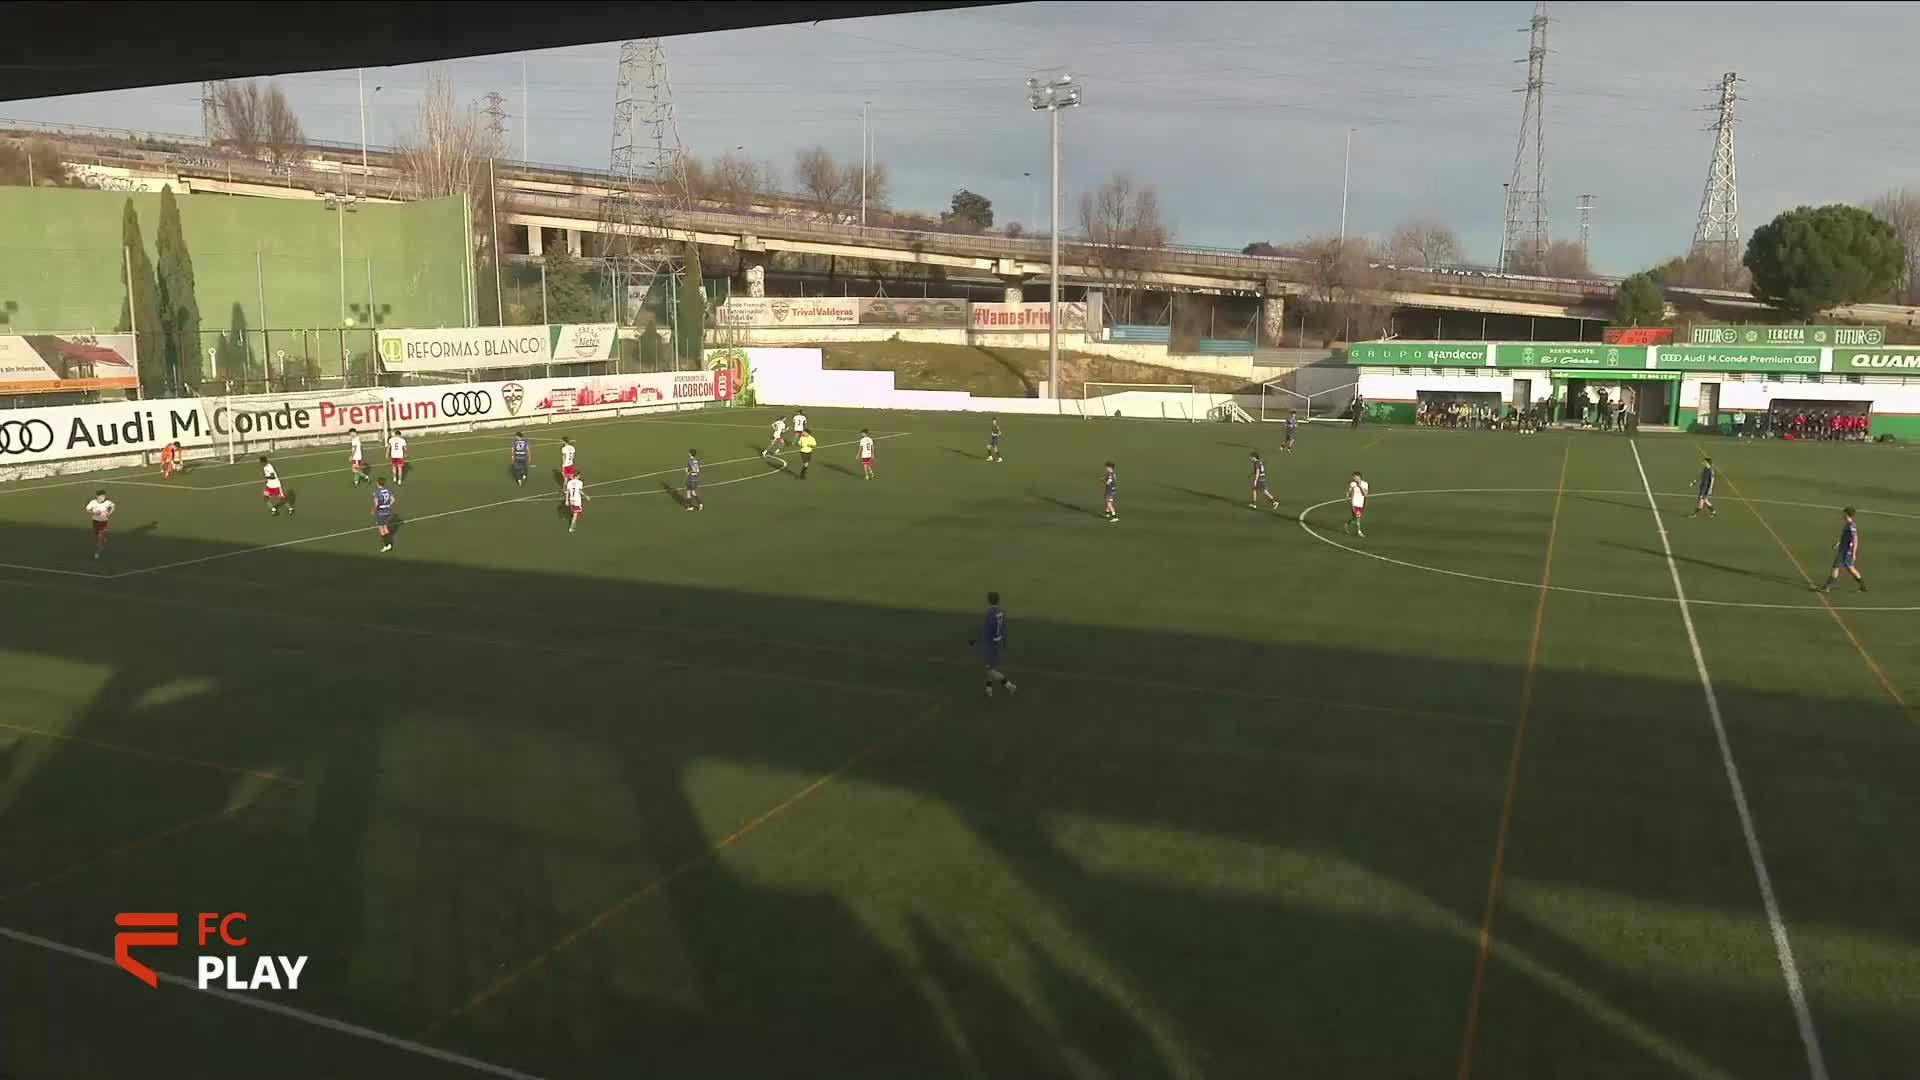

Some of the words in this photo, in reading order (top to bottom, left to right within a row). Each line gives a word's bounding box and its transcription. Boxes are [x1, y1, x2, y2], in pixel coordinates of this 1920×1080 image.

[1767, 328, 1805, 340] TERCERA
[407, 340, 480, 359] REFORMAS
[1427, 349, 1484, 364] afandecor
[1683, 355, 1705, 363] Audi
[1750, 355, 1793, 364] Premium
[66, 411, 156, 450] Audi
[320, 397, 437, 428] Premium
